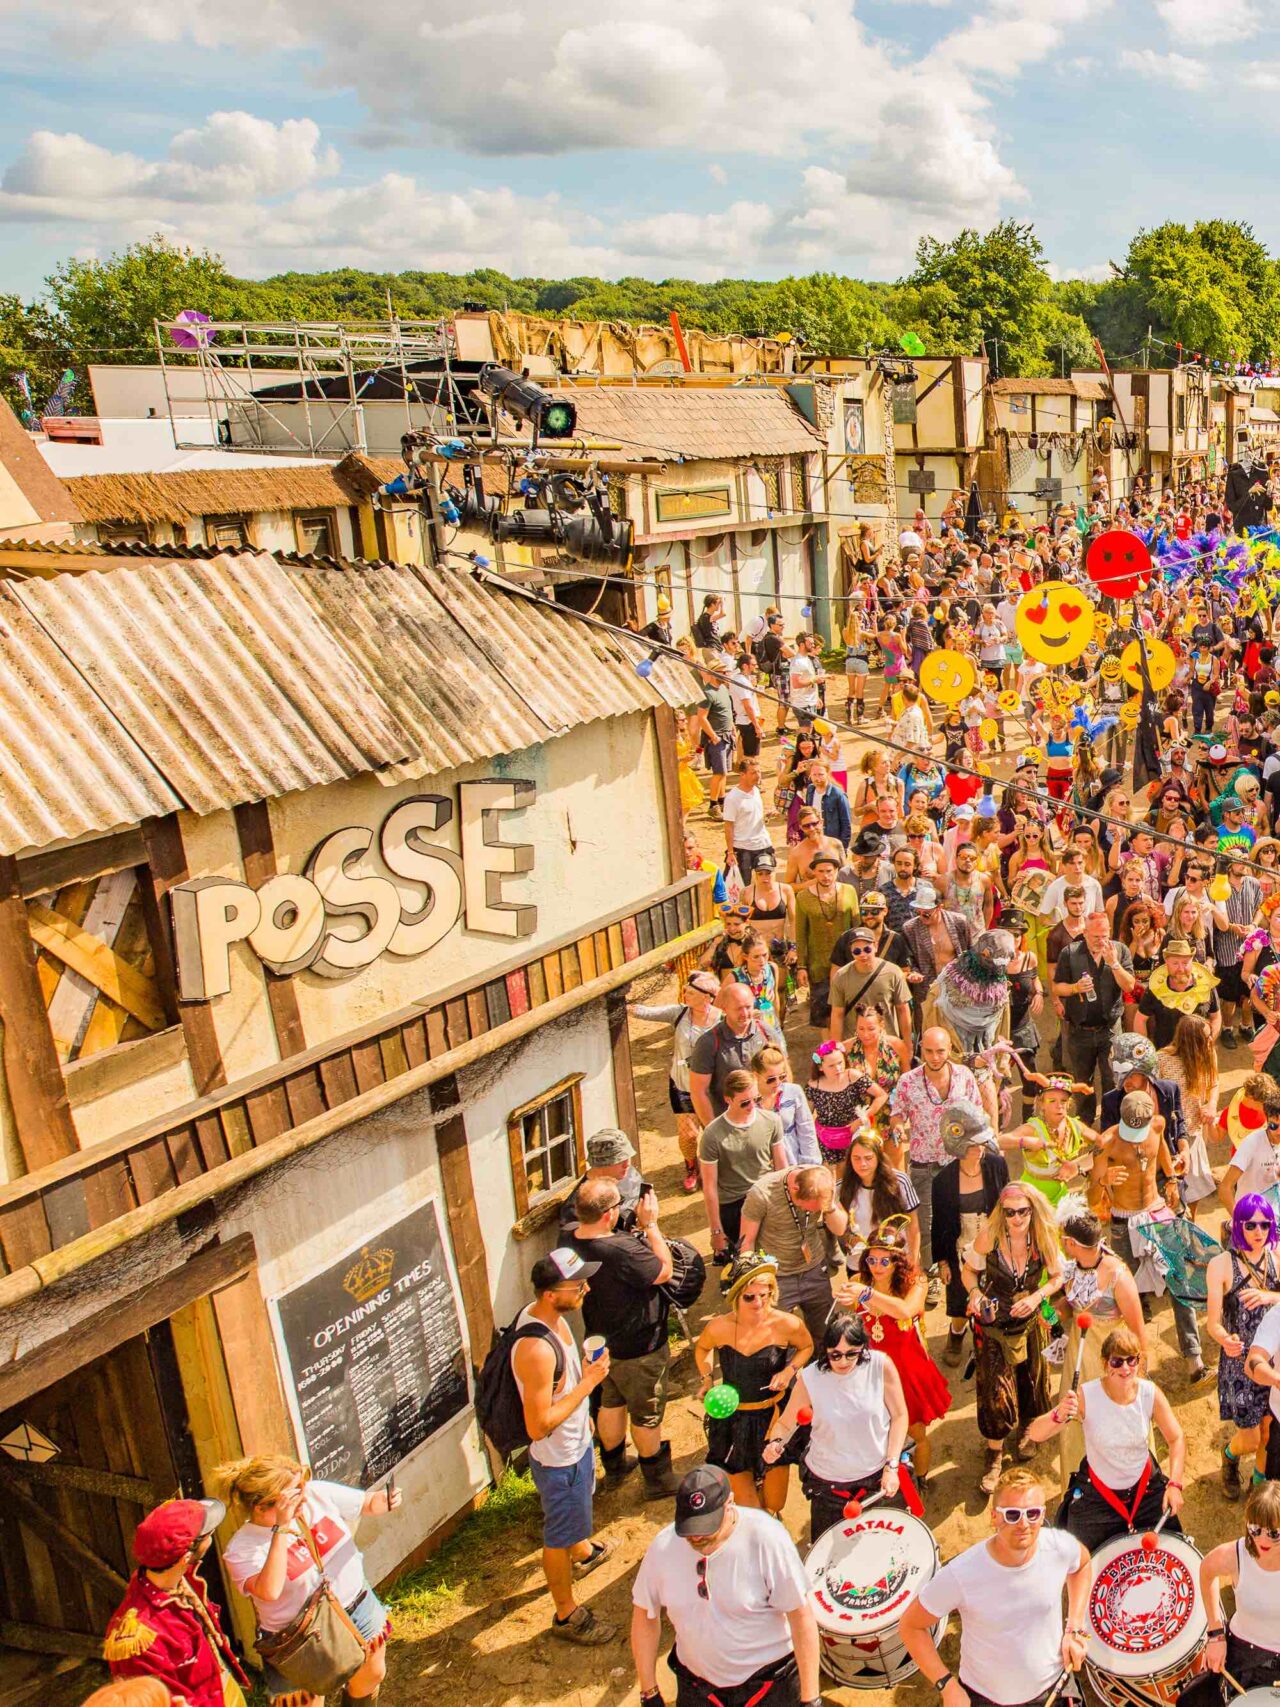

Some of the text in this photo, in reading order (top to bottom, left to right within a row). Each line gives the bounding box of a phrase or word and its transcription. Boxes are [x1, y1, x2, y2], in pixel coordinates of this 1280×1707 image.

[169, 778, 537, 1001] POSSE
[394, 1260, 432, 1292] TIMES
[351, 1322, 377, 1345] FRIDAY
[301, 1344, 346, 1377] THURSDAY
[843, 1520, 904, 1537] BATALA
[843, 1596, 880, 1607] FRANCE
